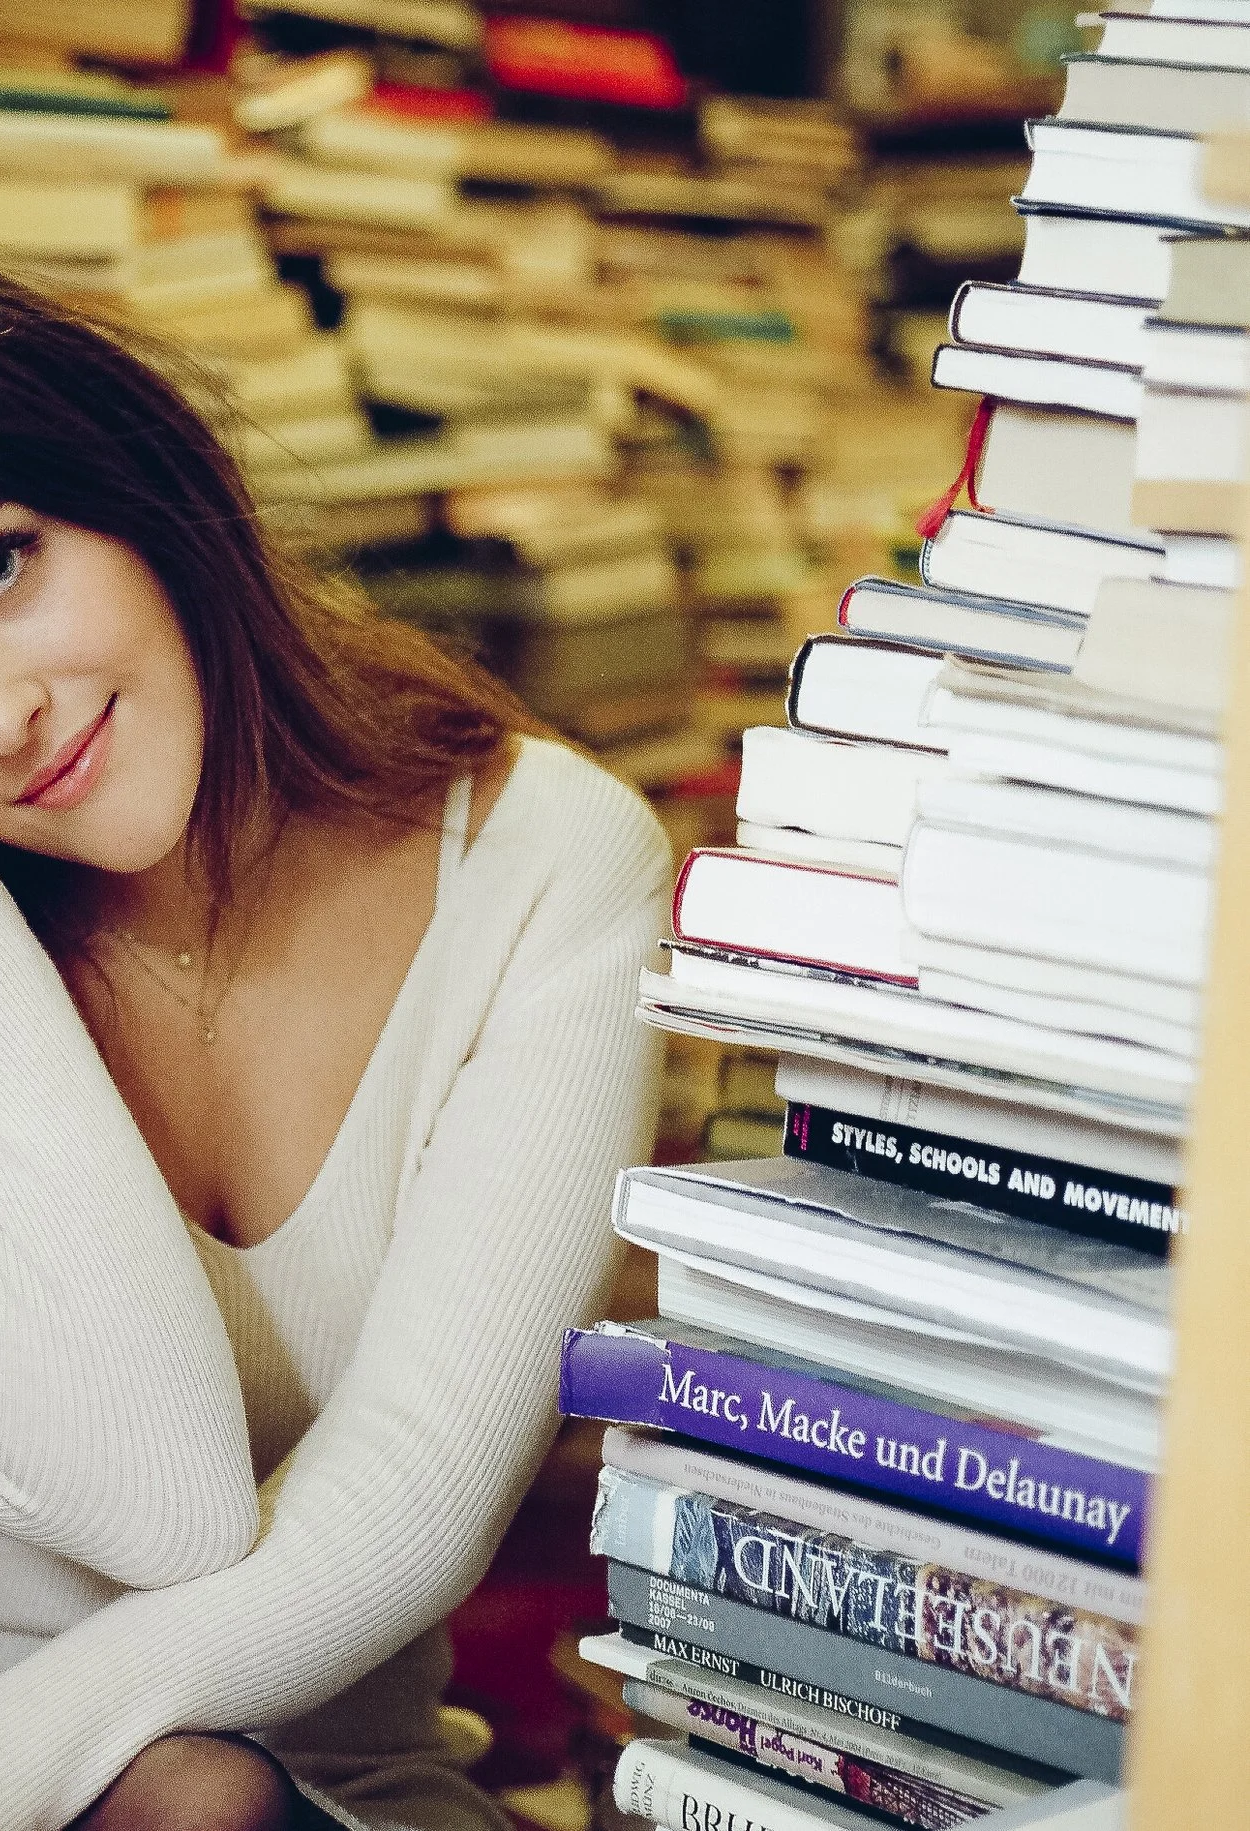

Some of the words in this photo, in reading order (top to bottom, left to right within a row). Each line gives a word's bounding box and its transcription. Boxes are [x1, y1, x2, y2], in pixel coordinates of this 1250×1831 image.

[830, 1121, 905, 1165] STYLES,
[908, 1142, 1001, 1186] SCHOOLS
[1007, 1168, 1056, 1201] AND
[658, 1363, 749, 1431] Marc,
[756, 1392, 866, 1460] Macke
[876, 1440, 947, 1483] und
[953, 1446, 1131, 1545] Delaunay
[649, 1576, 711, 1606] DOCUMENTA
[649, 1589, 687, 1611] KASSEL
[648, 1614, 671, 1630] 2007
[734, 1535, 1141, 1711] NEUSEELAND
[653, 1633, 689, 1660] MAX
[691, 1644, 740, 1677] ERNST
[759, 1669, 820, 1703] ULRICH
[822, 1690, 902, 1732] BISCHOFF
[874, 1669, 933, 1699] Bilderbuch
[798, 1750, 824, 1773] Karl
